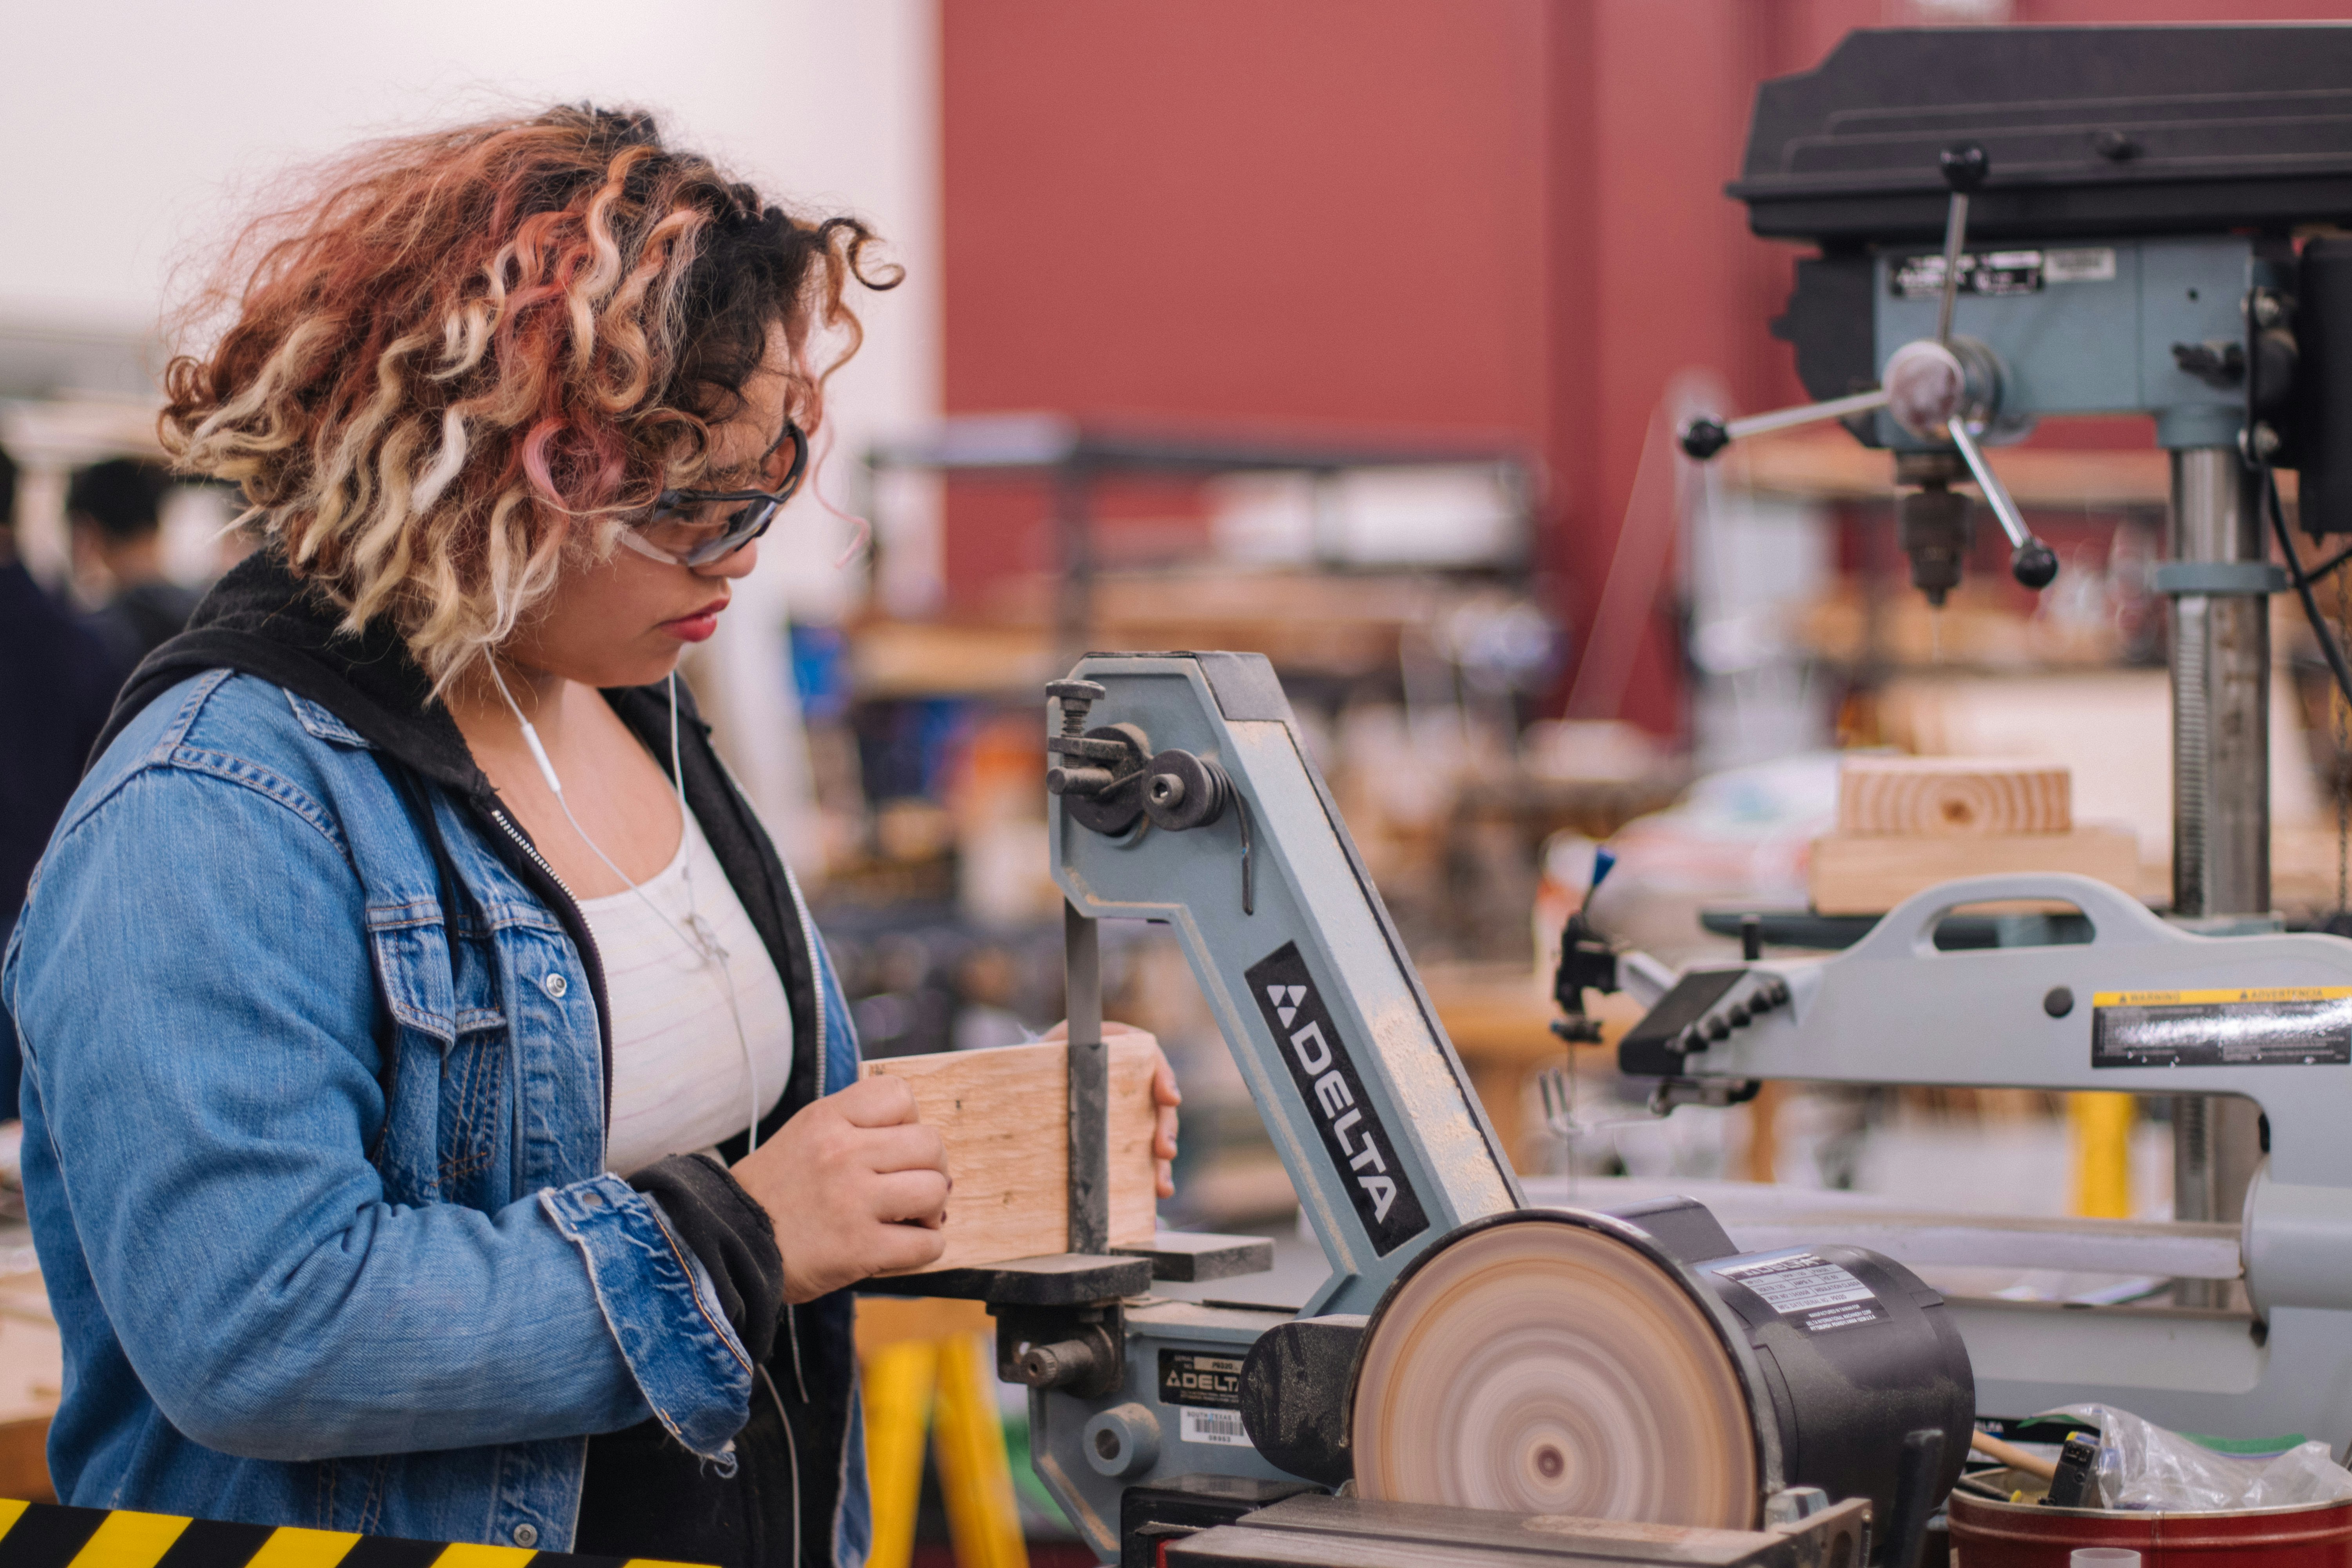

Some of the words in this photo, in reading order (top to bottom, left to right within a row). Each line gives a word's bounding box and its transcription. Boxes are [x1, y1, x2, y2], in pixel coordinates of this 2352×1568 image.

[1290, 1020, 1397, 1225] DELTA
[1814, 1284, 1842, 1292] INSULATION
[1182, 1373, 1240, 1392] DELT
